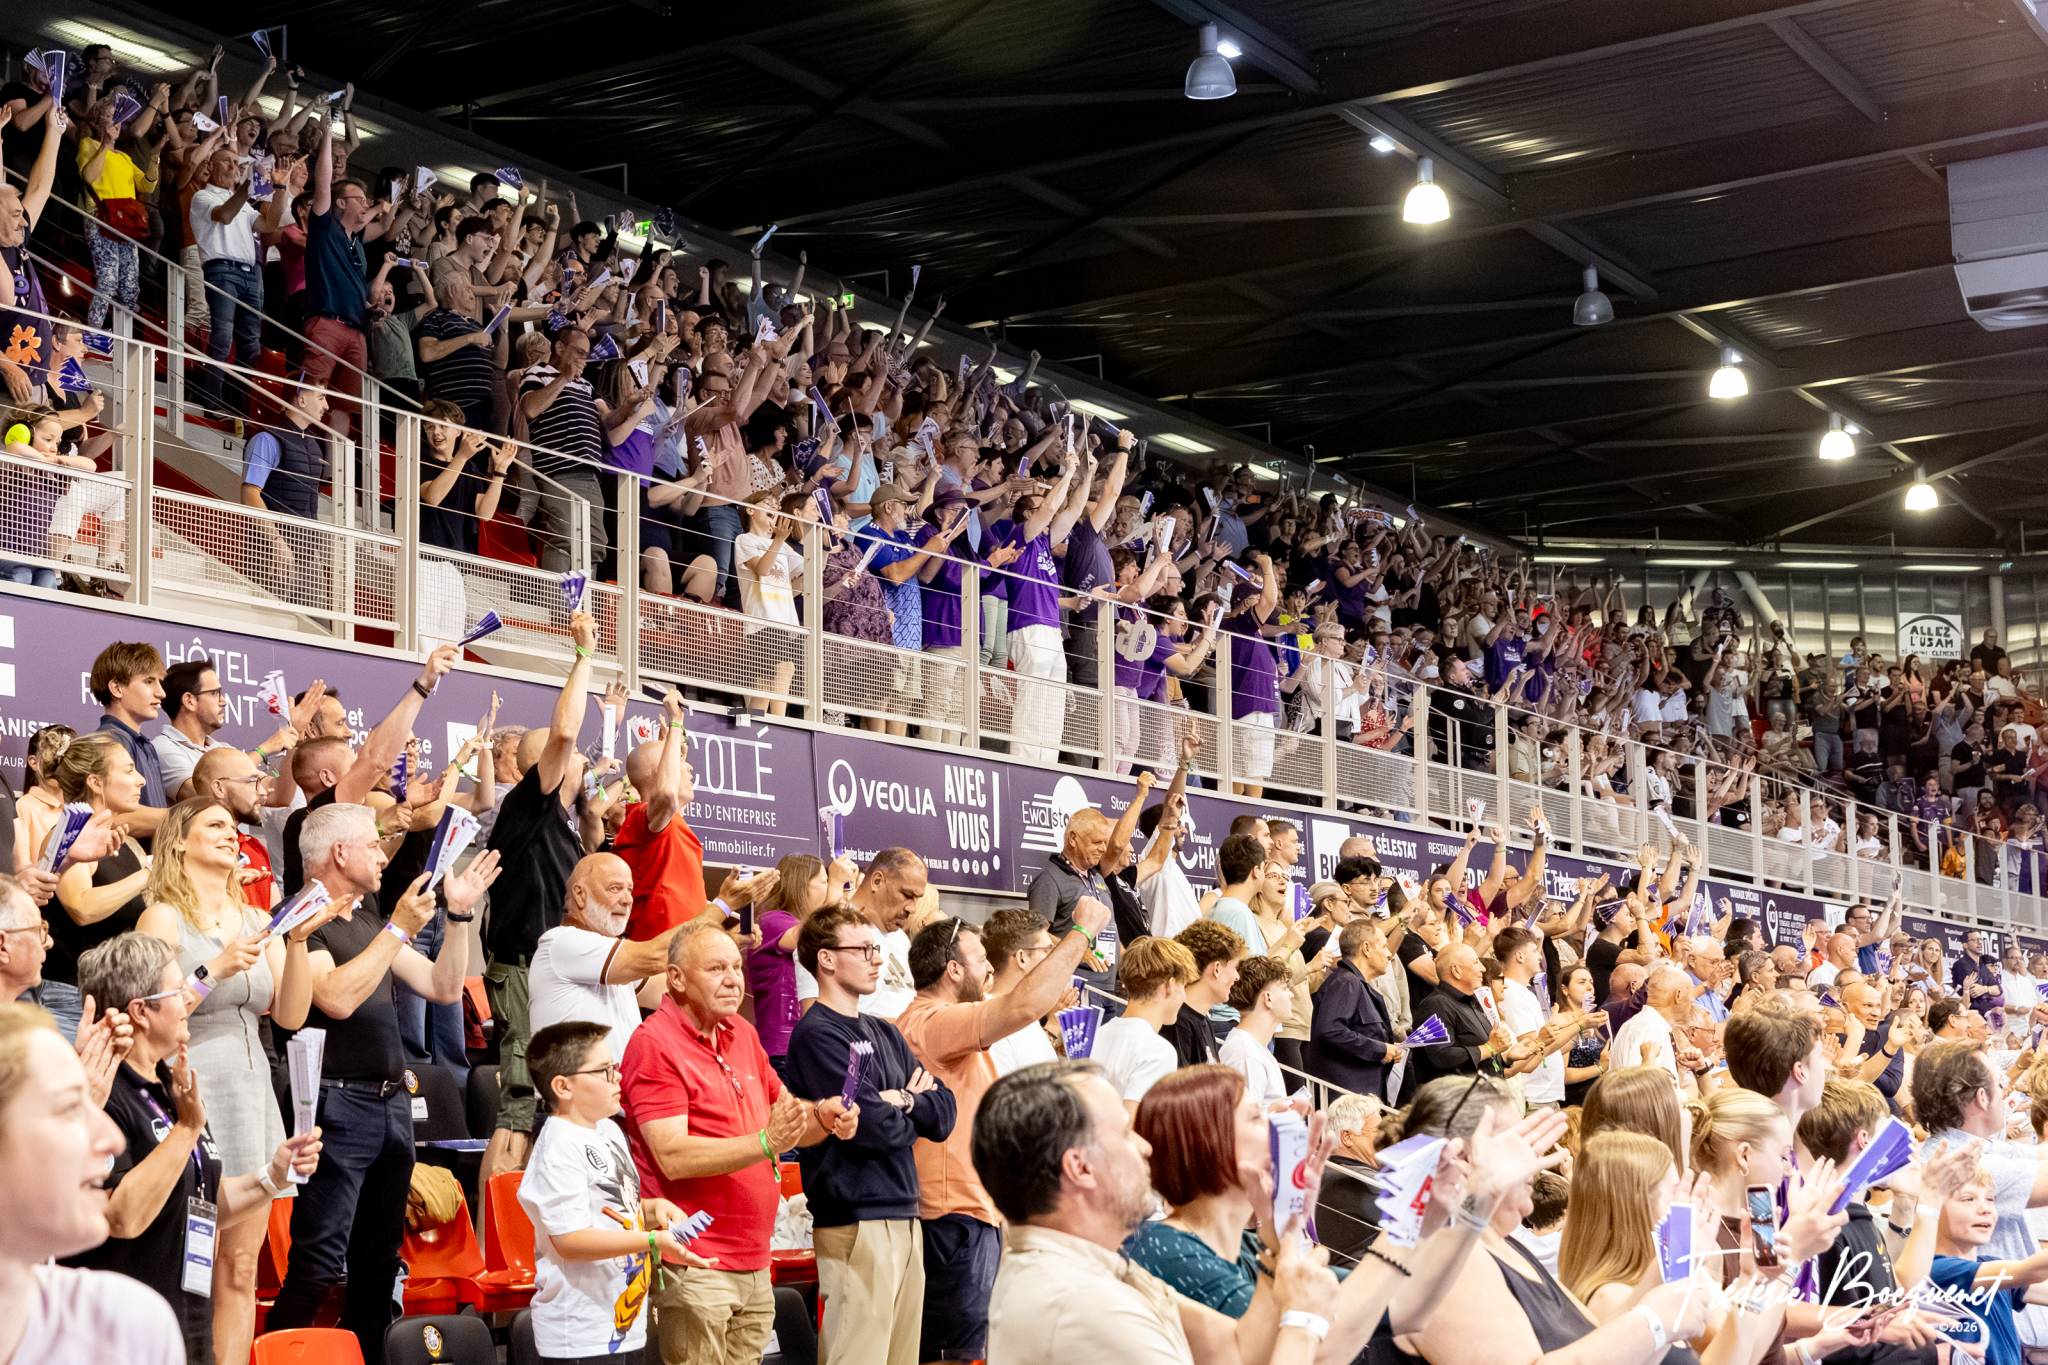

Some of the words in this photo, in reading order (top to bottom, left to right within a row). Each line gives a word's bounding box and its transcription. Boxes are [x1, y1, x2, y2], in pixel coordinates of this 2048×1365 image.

[1910, 625, 1950, 637] ALLEZ
[1910, 636, 1953, 648] L'USAM
[166, 636, 258, 685] HÔTEL
[860, 778, 937, 817] VEOLIA
[945, 765, 986, 808] AVEC
[705, 804, 777, 827] D'ENTREPRISE
[946, 809, 990, 853] VOUS
[1376, 833, 1416, 859] SÉLESTAT
[1321, 854, 1340, 880] BU
